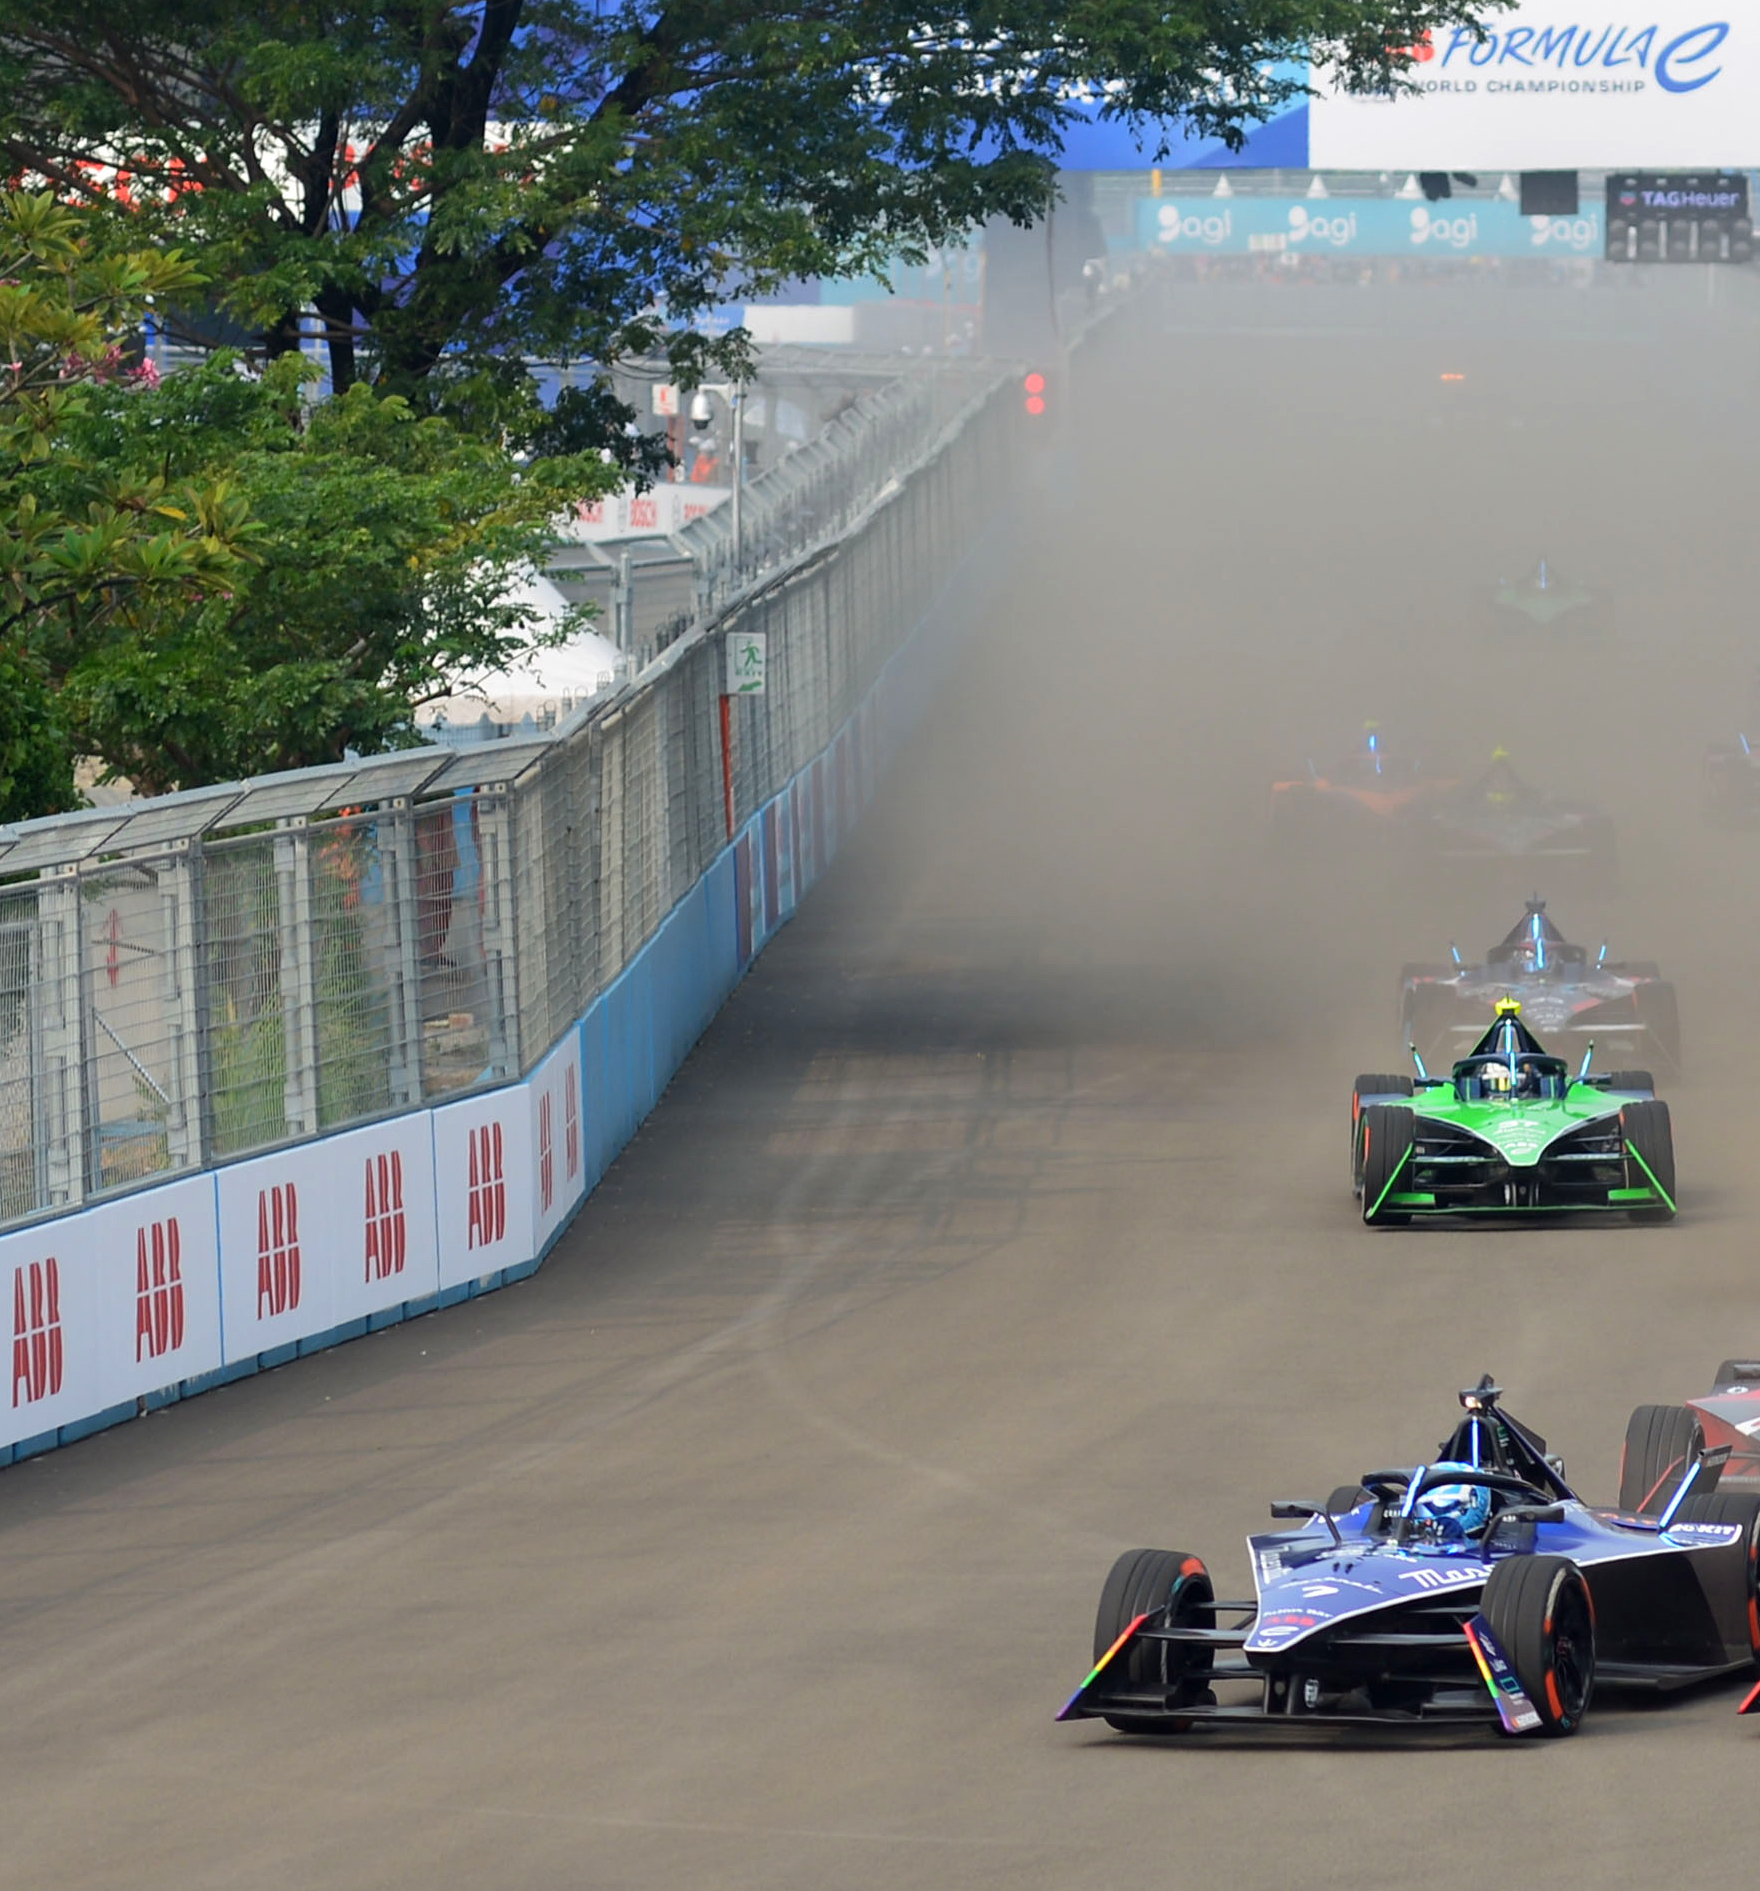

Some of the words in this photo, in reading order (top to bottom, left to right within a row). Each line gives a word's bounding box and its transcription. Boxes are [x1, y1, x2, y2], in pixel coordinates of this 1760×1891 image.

[1441, 22, 1658, 69] FORMULA
[1486, 79, 1647, 93] CHAMPIONSHIP
[257, 1182, 302, 1321] ABB
[365, 1149, 406, 1284] ABB
[468, 1121, 506, 1251] ABB
[12, 1256, 64, 1409] ABB
[136, 1216, 185, 1364] ABB
